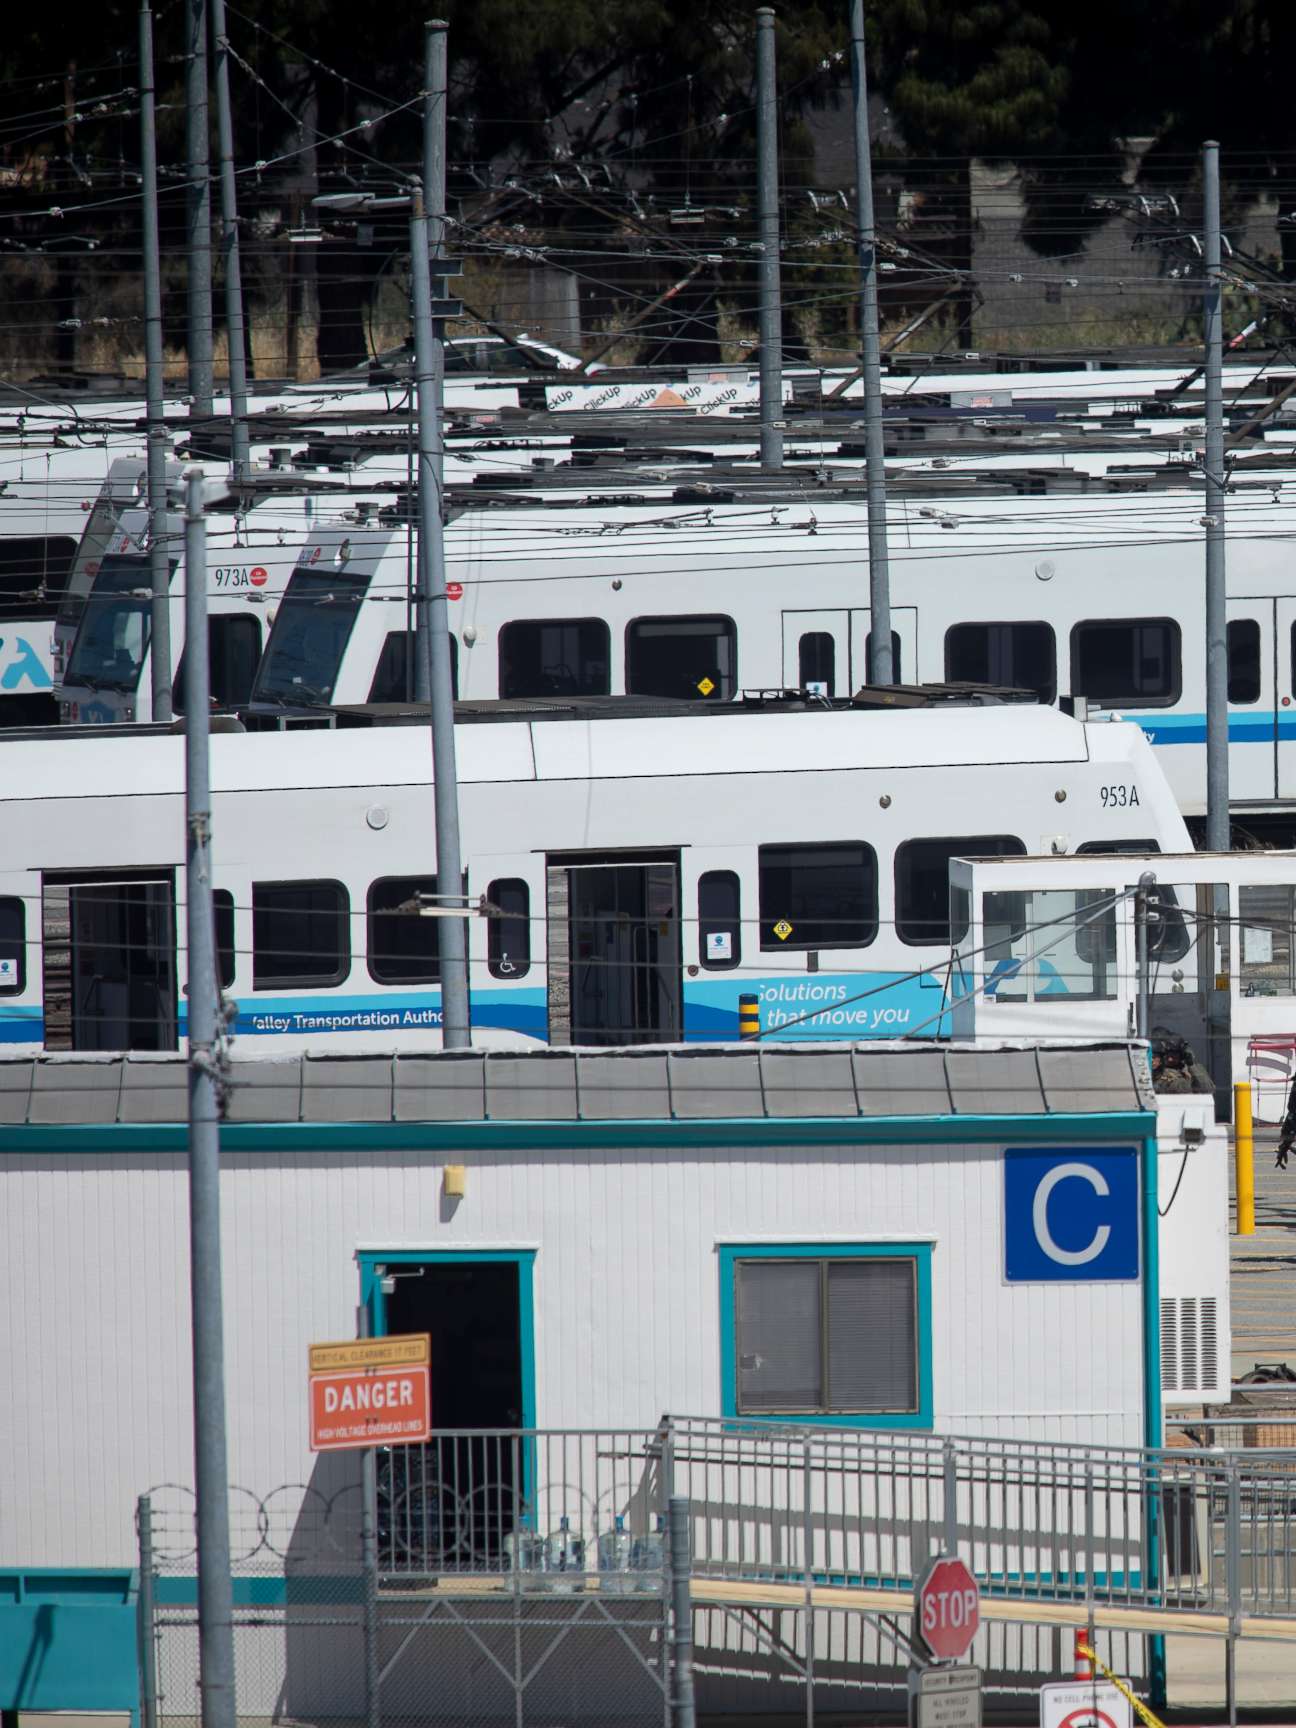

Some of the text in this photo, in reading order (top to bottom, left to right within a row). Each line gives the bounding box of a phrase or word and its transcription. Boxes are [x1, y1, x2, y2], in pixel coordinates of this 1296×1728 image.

[584, 386, 621, 411] ClickUp
[701, 388, 737, 414] ClickUp
[215, 568, 249, 587] 973A
[1100, 785, 1140, 808] 953A
[293, 1011, 400, 1030] Transportation
[767, 1008, 910, 1029] that move you
[1032, 1162, 1112, 1266] C
[324, 1379, 414, 1414] DANGER
[923, 1589, 977, 1631] STOP
[1064, 1694, 1081, 1704] CELL
